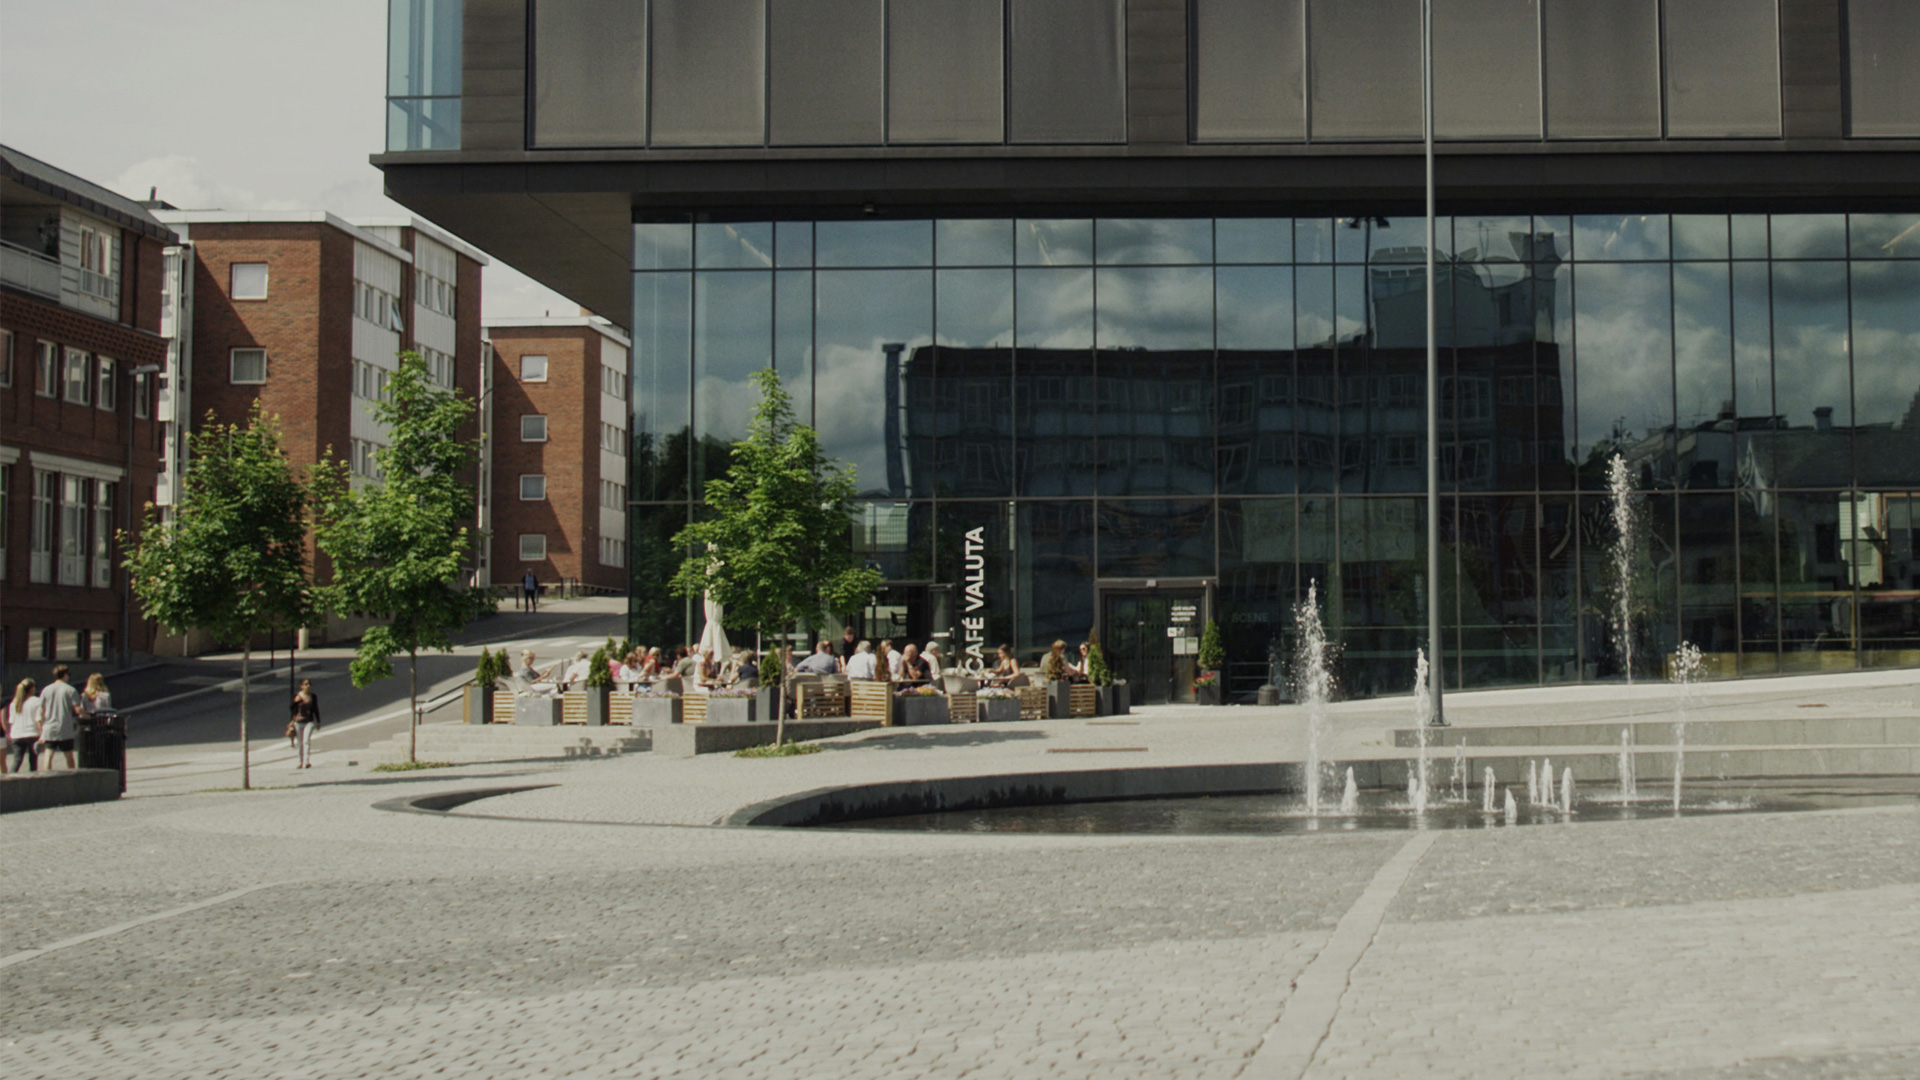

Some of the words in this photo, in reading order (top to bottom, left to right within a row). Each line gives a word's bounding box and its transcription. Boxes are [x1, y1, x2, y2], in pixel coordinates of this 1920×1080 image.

[965, 526, 984, 612] VALUTA
[961, 616, 984, 677] CAFÉ
[1231, 612, 1269, 623] SCENE
